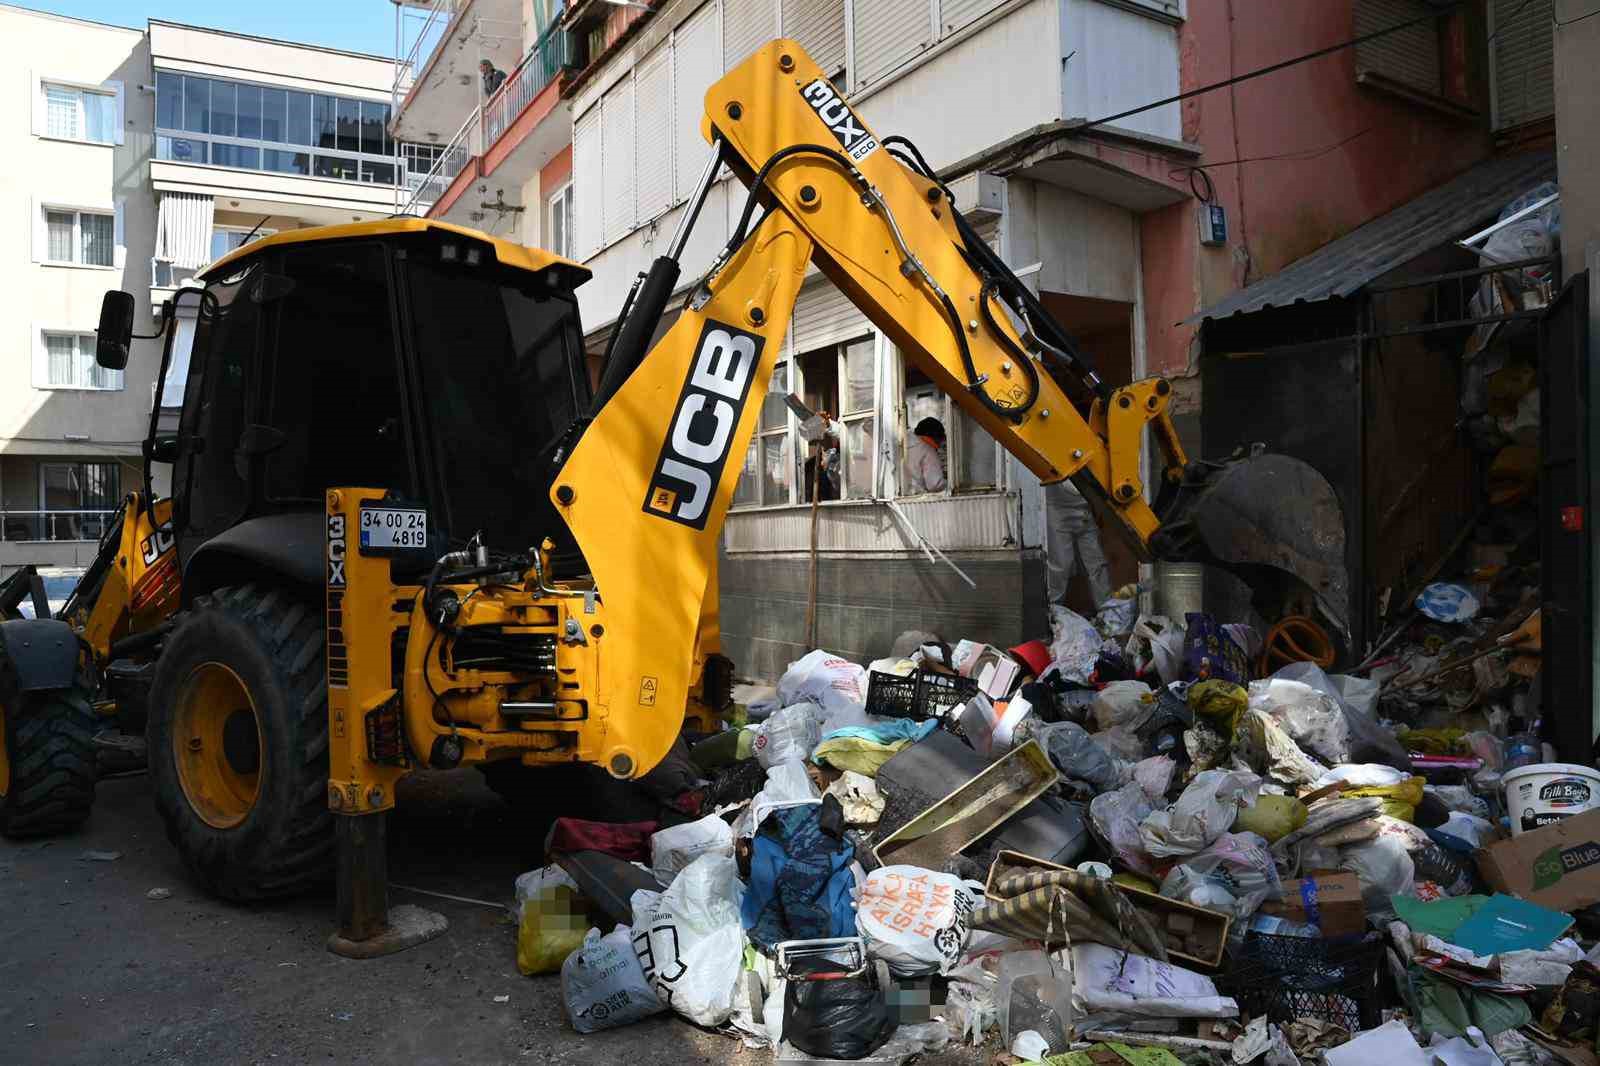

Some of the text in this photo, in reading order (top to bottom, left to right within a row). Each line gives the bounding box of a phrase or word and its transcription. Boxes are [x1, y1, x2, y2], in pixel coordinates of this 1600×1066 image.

[804, 80, 866, 147] 3CX
[853, 141, 876, 160] ECO
[660, 329, 756, 520] JCB
[363, 513, 425, 529] 34 00 24
[392, 531, 425, 545] 4819
[328, 516, 345, 584] 3CX
